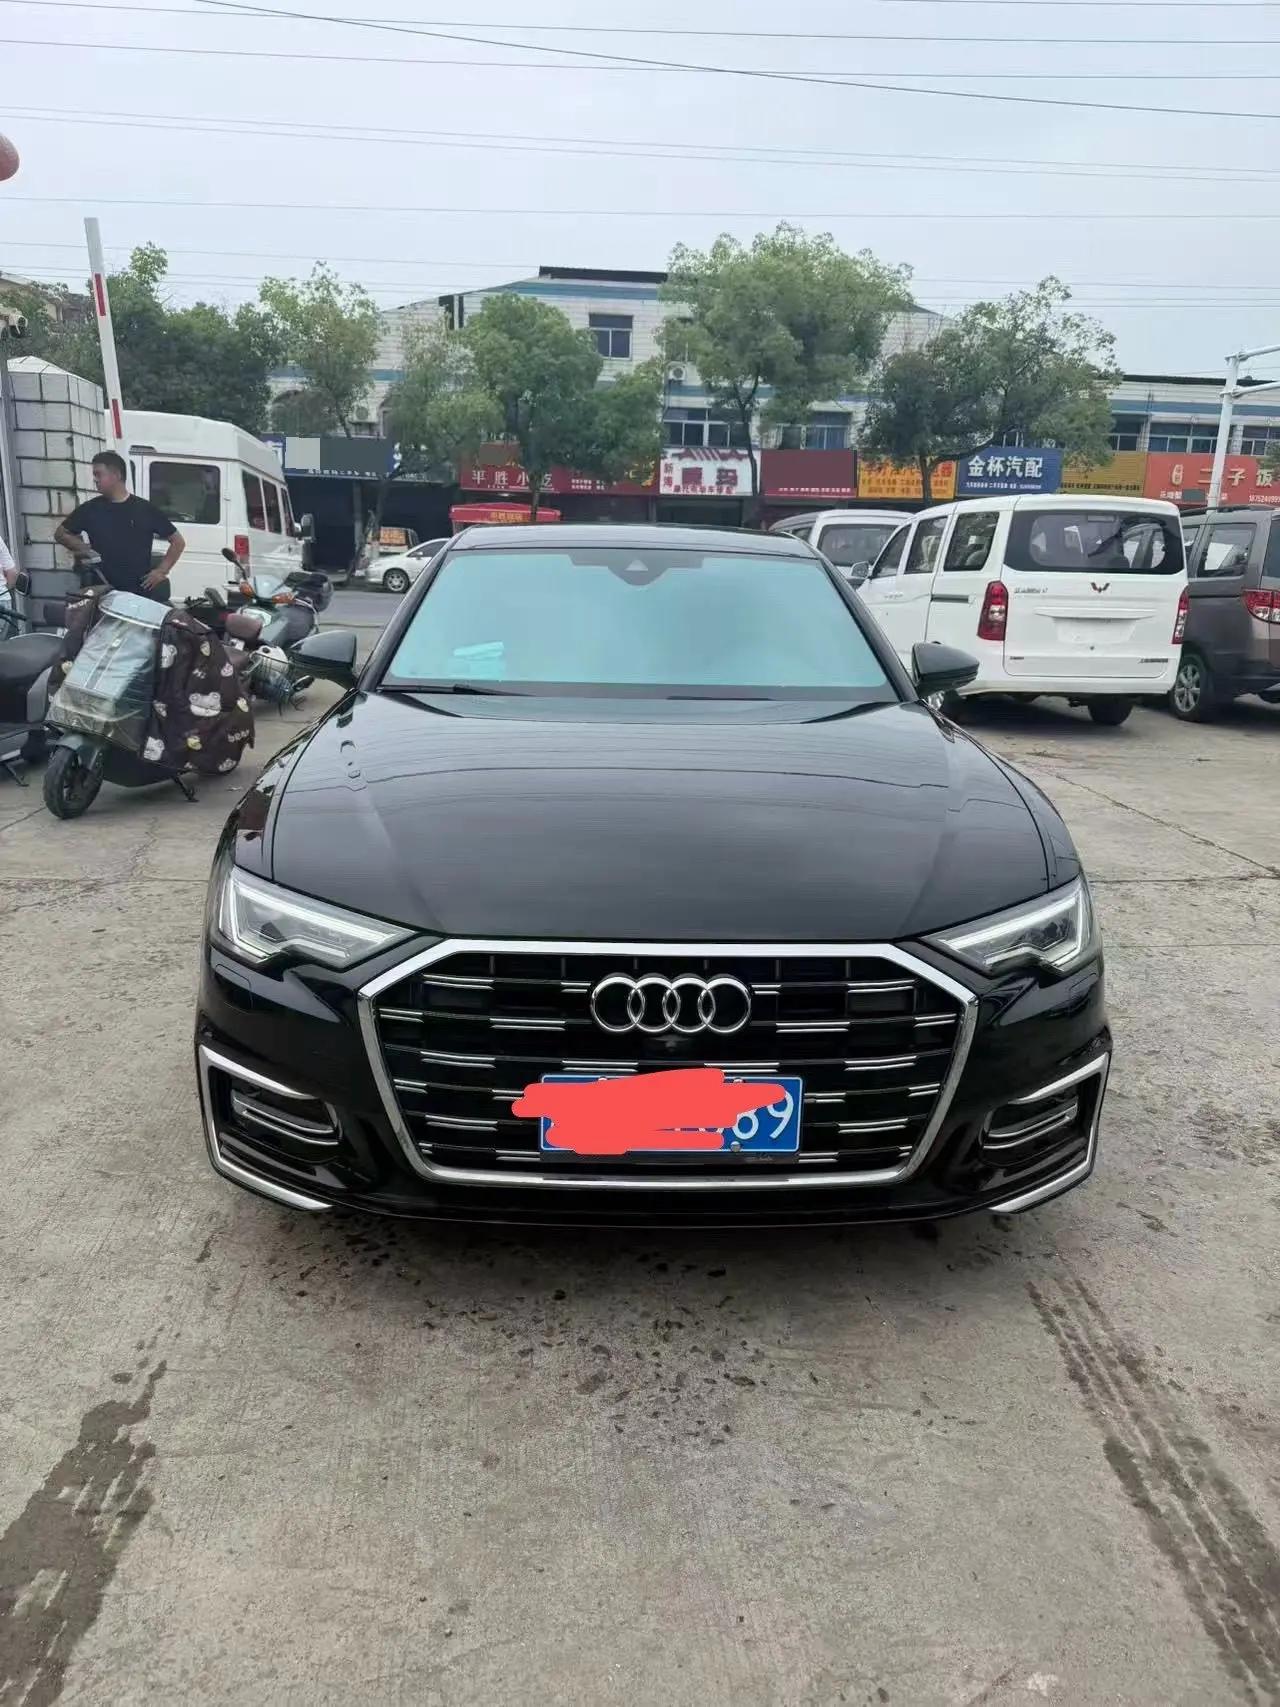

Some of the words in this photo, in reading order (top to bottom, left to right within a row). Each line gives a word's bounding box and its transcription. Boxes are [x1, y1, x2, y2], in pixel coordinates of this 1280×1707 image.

[968, 455, 1043, 478] 金杯汽配
[1197, 468, 1280, 487] 二子饭
